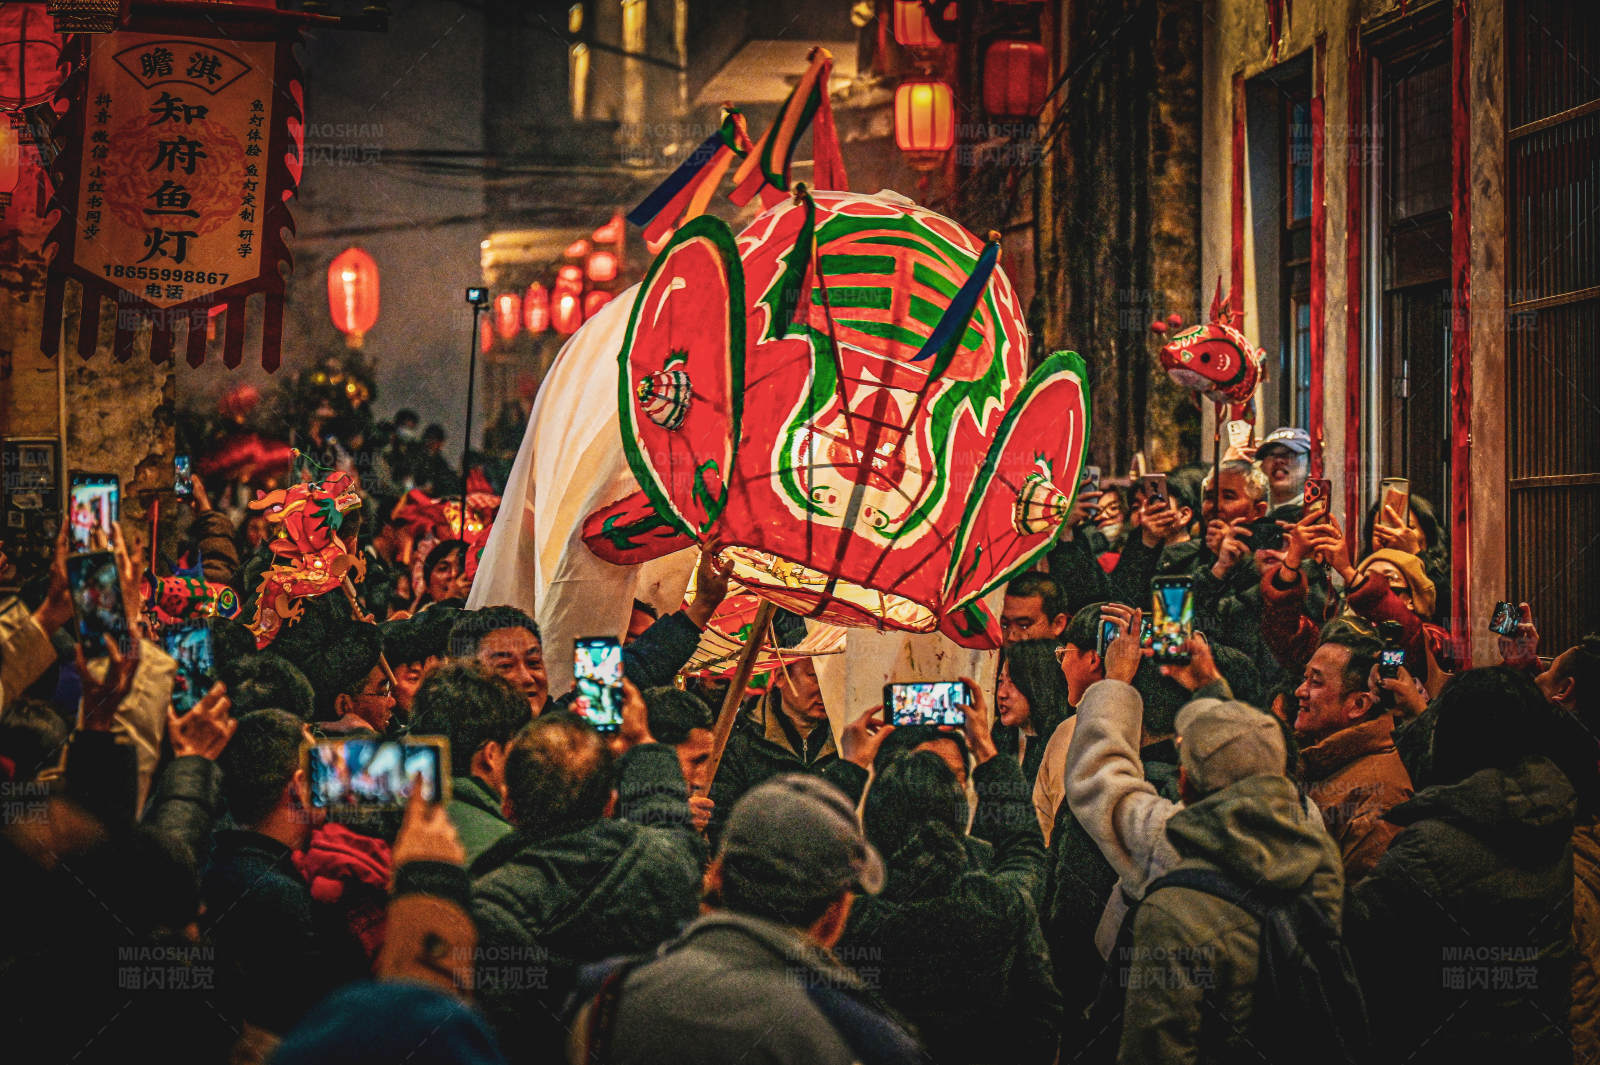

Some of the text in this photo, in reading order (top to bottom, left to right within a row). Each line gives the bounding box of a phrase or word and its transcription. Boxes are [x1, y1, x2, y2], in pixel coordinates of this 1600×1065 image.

[135, 91, 210, 265] 知府鱼灯
[236, 98, 265, 259] 鱼灯体验 鱼灯定制 研学
[103, 264, 230, 287] 18655998867
[145, 282, 185, 301] 电话
